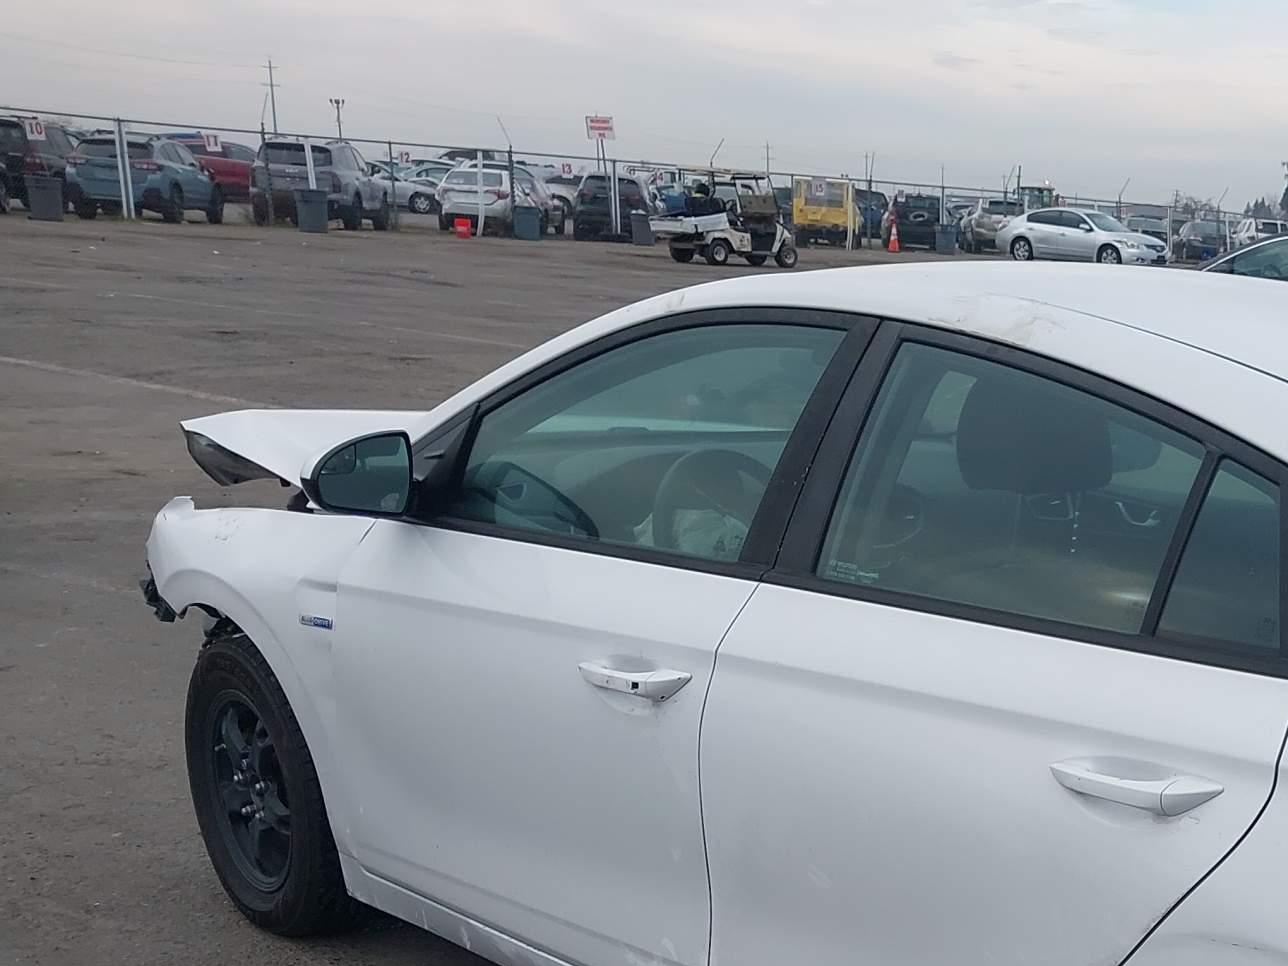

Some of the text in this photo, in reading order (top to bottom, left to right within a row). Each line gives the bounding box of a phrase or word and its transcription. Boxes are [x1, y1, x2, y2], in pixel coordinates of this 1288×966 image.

[29, 121, 43, 135] 10
[399, 151, 412, 164] 12
[561, 163, 573, 175] 13
[815, 183, 824, 193] 15
